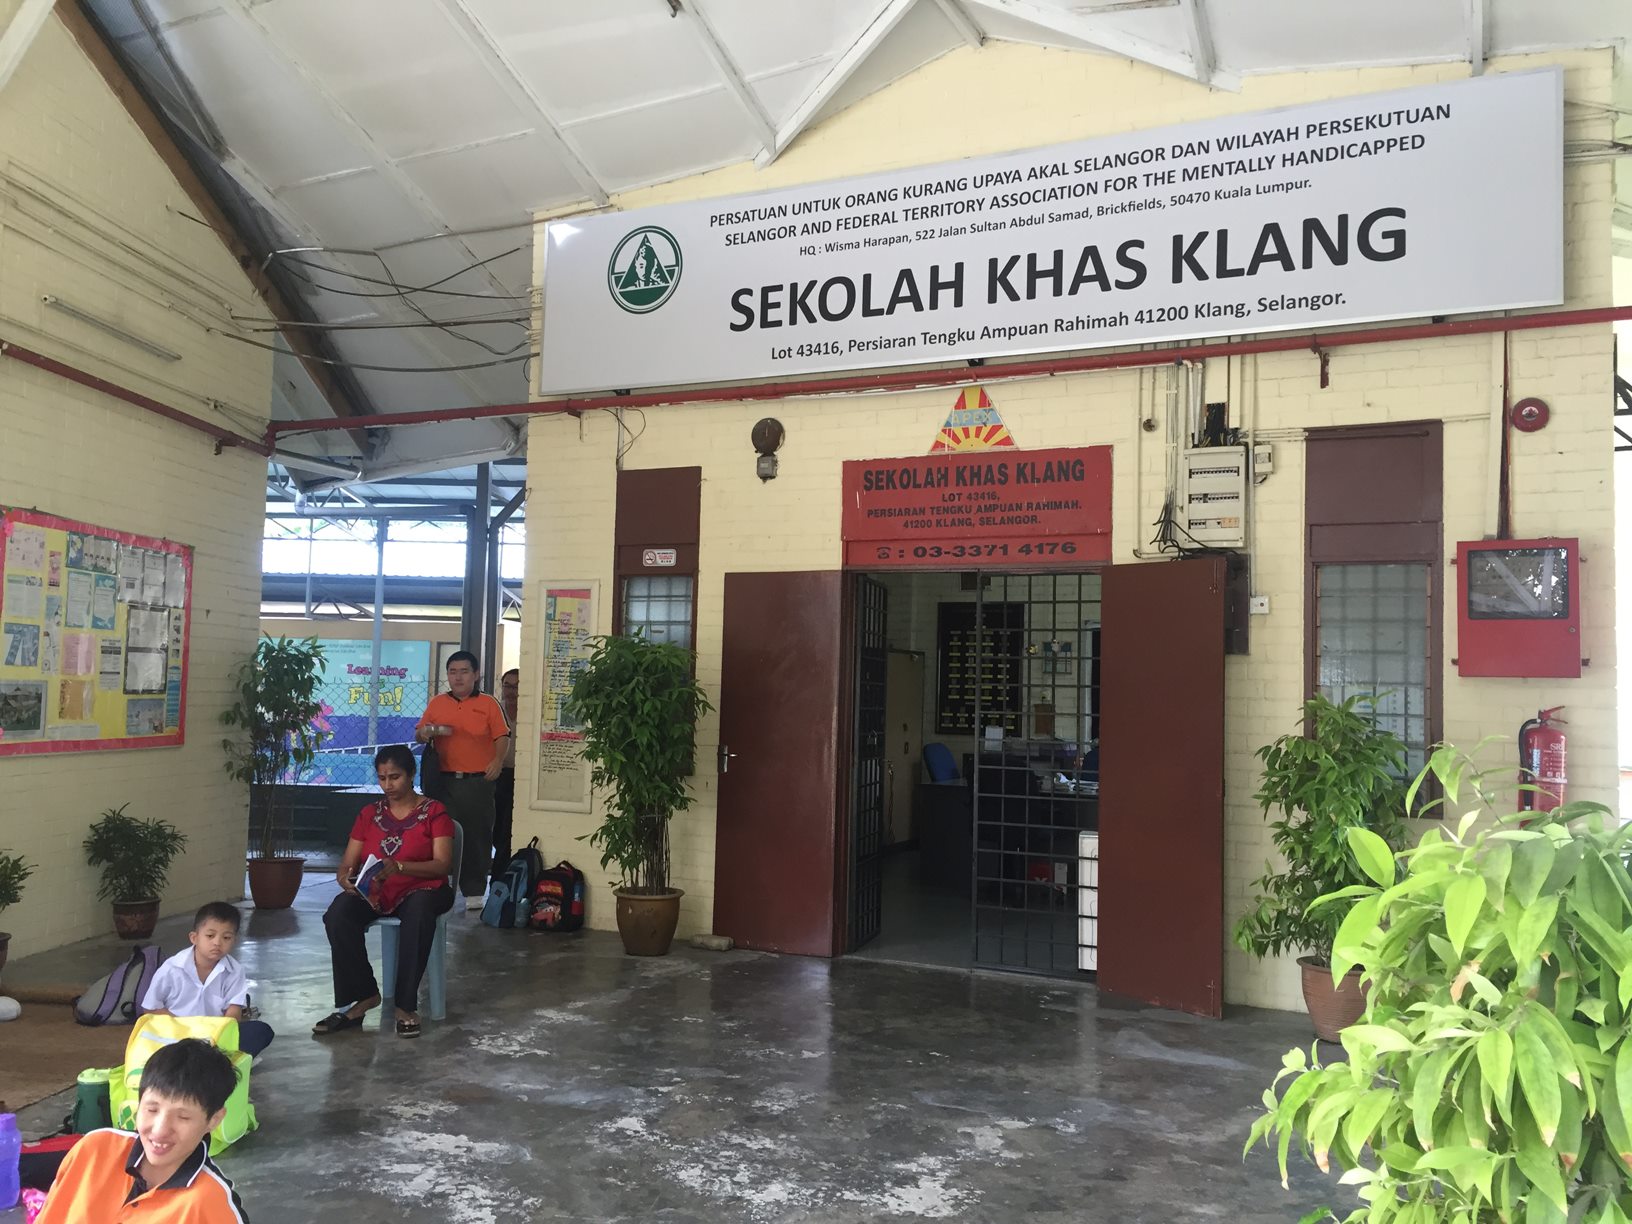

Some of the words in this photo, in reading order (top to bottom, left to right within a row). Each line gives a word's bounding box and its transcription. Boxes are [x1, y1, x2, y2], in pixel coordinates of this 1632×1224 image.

[710, 204, 787, 227] PERSATUAN
[792, 196, 840, 215] UNTUK
[845, 188, 898, 207] ORANG
[903, 177, 967, 199] KURANG
[973, 169, 1022, 188] UPAYA
[1027, 162, 1069, 181] AKAL
[1074, 147, 1165, 173] SELANGOR
[1172, 140, 1209, 159] DAN
[1216, 126, 1299, 151] WILAYAH
[1306, 103, 1450, 138] PERSEKUTUAN
[725, 225, 796, 246] SELANGOR
[800, 220, 831, 235] AND
[836, 210, 898, 231] FEDERAL
[902, 197, 985, 221] TERRITORY
[989, 181, 1098, 209] ASSOCIATION
[1104, 175, 1137, 193] FOR
[1142, 169, 1175, 187] THE
[1182, 154, 1275, 182] MENTALLY
[1282, 134, 1424, 167] HANDICAPPED
[799, 245, 816, 255] HQ
[824, 241, 859, 252] Wisma
[863, 234, 911, 247] Harapan,
[915, 229, 935, 240] 522
[938, 226, 966, 237] Jalan
[970, 221, 1005, 233] Sultan
[1009, 213, 1044, 228] Abdul
[1048, 207, 1092, 223] Samad,
[1097, 197, 1165, 216] Brickfields,
[1170, 191, 1210, 206] 50470
[1214, 185, 1251, 200] Kuala
[1256, 179, 1311, 194] Lumpur.
[729, 261, 964, 332] SEKOLAH
[987, 239, 1147, 304] KHAS
[1172, 207, 1406, 284] KLANG
[771, 346, 792, 359] Lot
[796, 340, 843, 357] 43416,
[848, 336, 916, 352] Persiaran
[920, 327, 975, 346] Tengku
[980, 323, 1048, 340] Ampuan
[1054, 311, 1128, 332] Rahimah
[1134, 305, 1188, 323] 41200
[1195, 302, 1251, 318] Klang,
[1257, 292, 1345, 312] Selangor.
[952, 412, 993, 424] APEX
[863, 466, 949, 491] SEKOLAH
[955, 462, 1009, 487] KHAS
[1016, 459, 1085, 483] KLANG
[867, 506, 926, 518] PERSIARAN
[930, 503, 973, 515] TENGKU
[976, 502, 1023, 513] AMPUAN
[1026, 500, 1082, 511] RAHIMAH.
[942, 492, 963, 502] LOT
[966, 491, 1000, 502] 43416,
[903, 519, 933, 529] 41200
[936, 516, 975, 528] KLANG,
[979, 514, 1041, 526] SELANGOR.
[912, 544, 1010, 559] 03-3371
[1018, 541, 1077, 556] 4176
